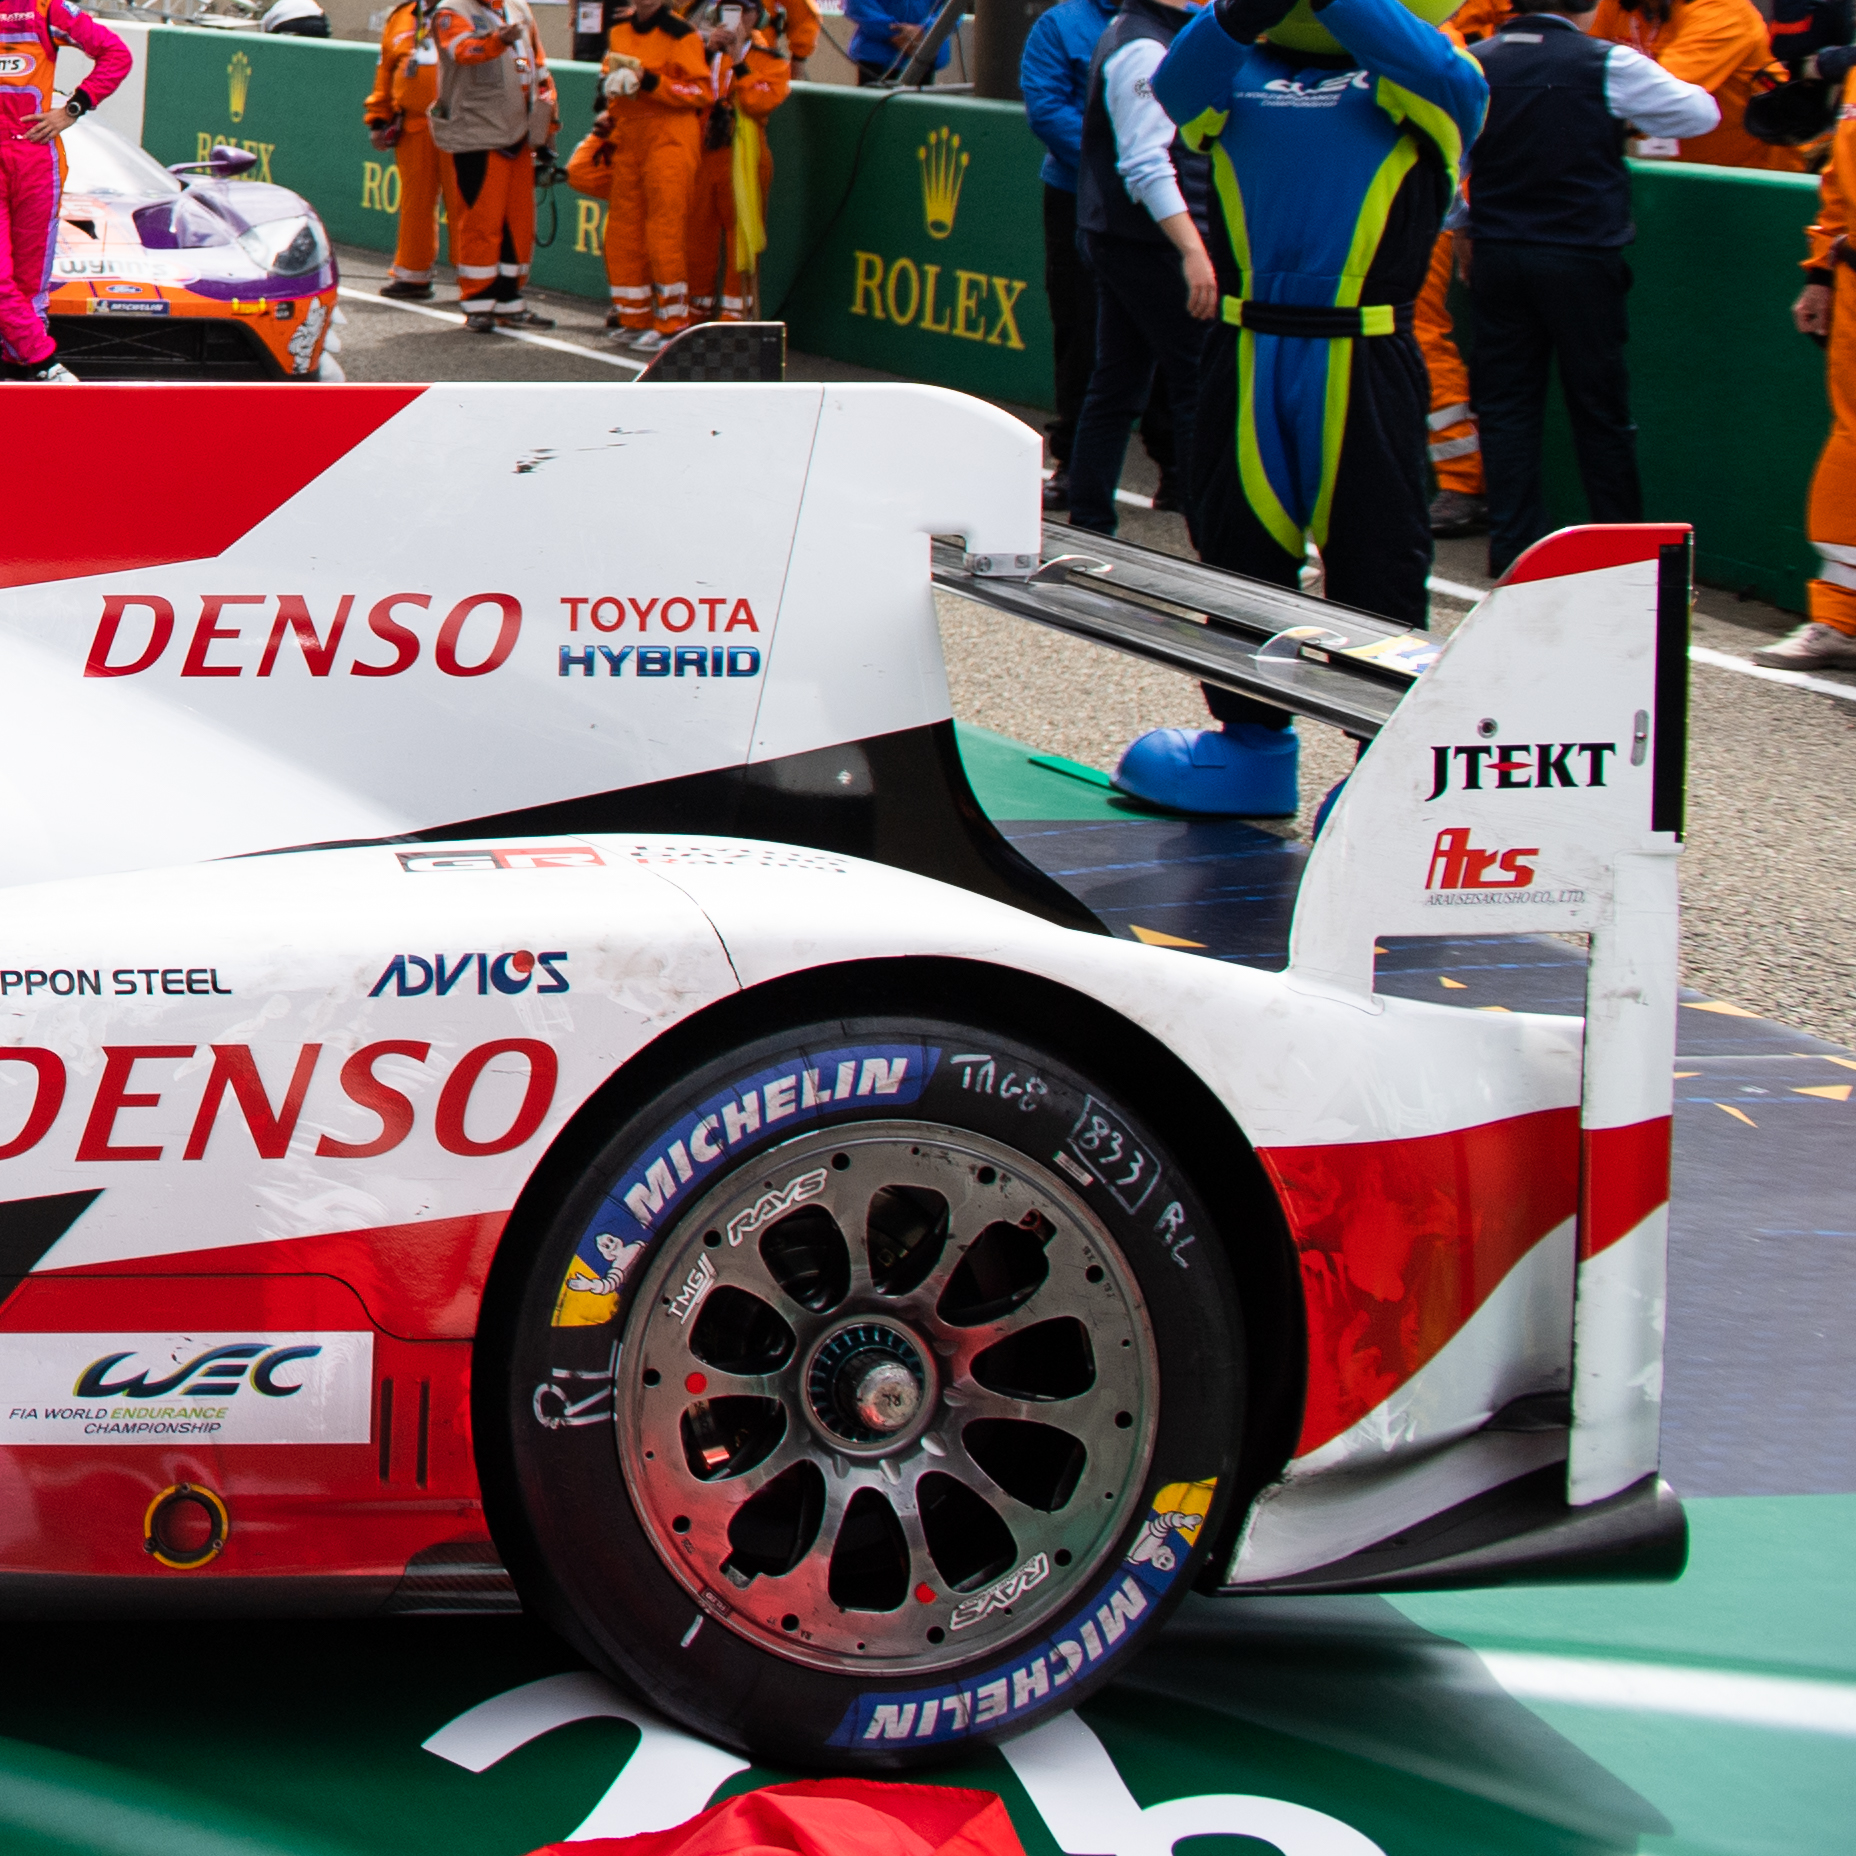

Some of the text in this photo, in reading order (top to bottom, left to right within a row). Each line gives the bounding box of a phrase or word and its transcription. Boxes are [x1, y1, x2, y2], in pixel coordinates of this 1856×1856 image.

[850, 249, 1027, 352] ROLEX
[82, 591, 525, 679] DENSO
[560, 595, 759, 635] TOYOTA
[557, 644, 762, 679] HYBRID
[1424, 742, 1617, 802] JTEKT
[1425, 893, 1455, 906] ARAI
[1456, 891, 1530, 906] SEISAKUSHO
[1558, 891, 1586, 904] LTD.
[112, 966, 232, 997] STEEL
[367, 950, 571, 999] ADVICS
[623, 1053, 911, 1225] MICHELIN
[1079, 1115, 1143, 1188] 833
[726, 1167, 829, 1246] RAYS
[1156, 1201, 1191, 1270] RL
[72, 1343, 322, 1400] WEC
[532, 1342, 620, 1431] RL
[8, 1405, 228, 1422] FIA WORLD ENDURANCE
[83, 1419, 223, 1436] CHAMPIONSHIP
[950, 1552, 1051, 1632] RAYS
[867, 1580, 1151, 1742] MICHELIN
